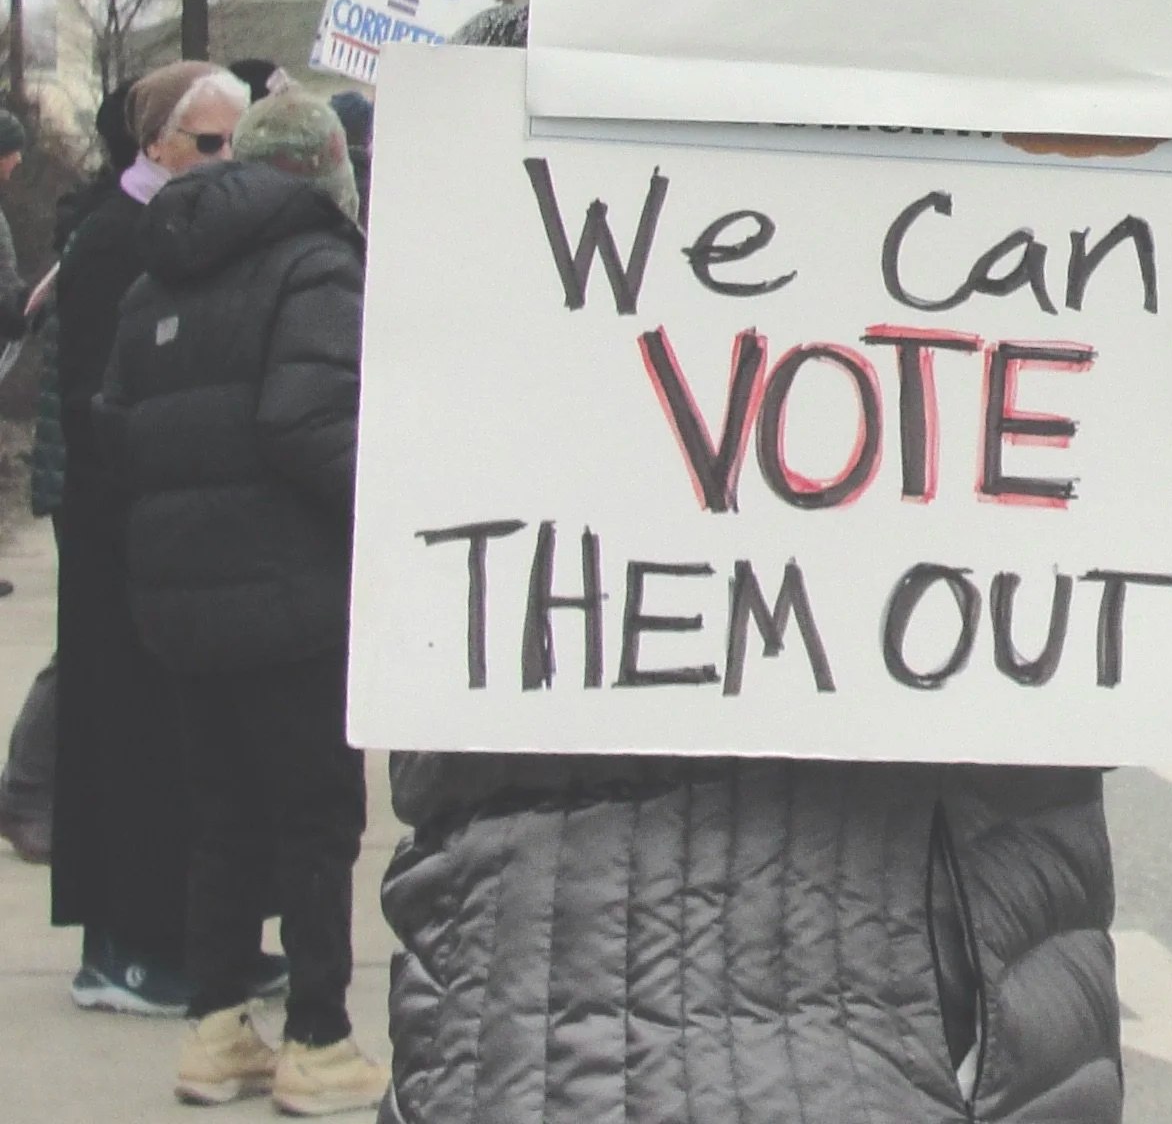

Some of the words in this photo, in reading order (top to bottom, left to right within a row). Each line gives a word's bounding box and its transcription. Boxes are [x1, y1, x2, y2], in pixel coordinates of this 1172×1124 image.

[523, 156, 798, 315] We
[881, 190, 1159, 316] Can
[635, 324, 1098, 513] VOTE
[414, 519, 836, 696] THEM
